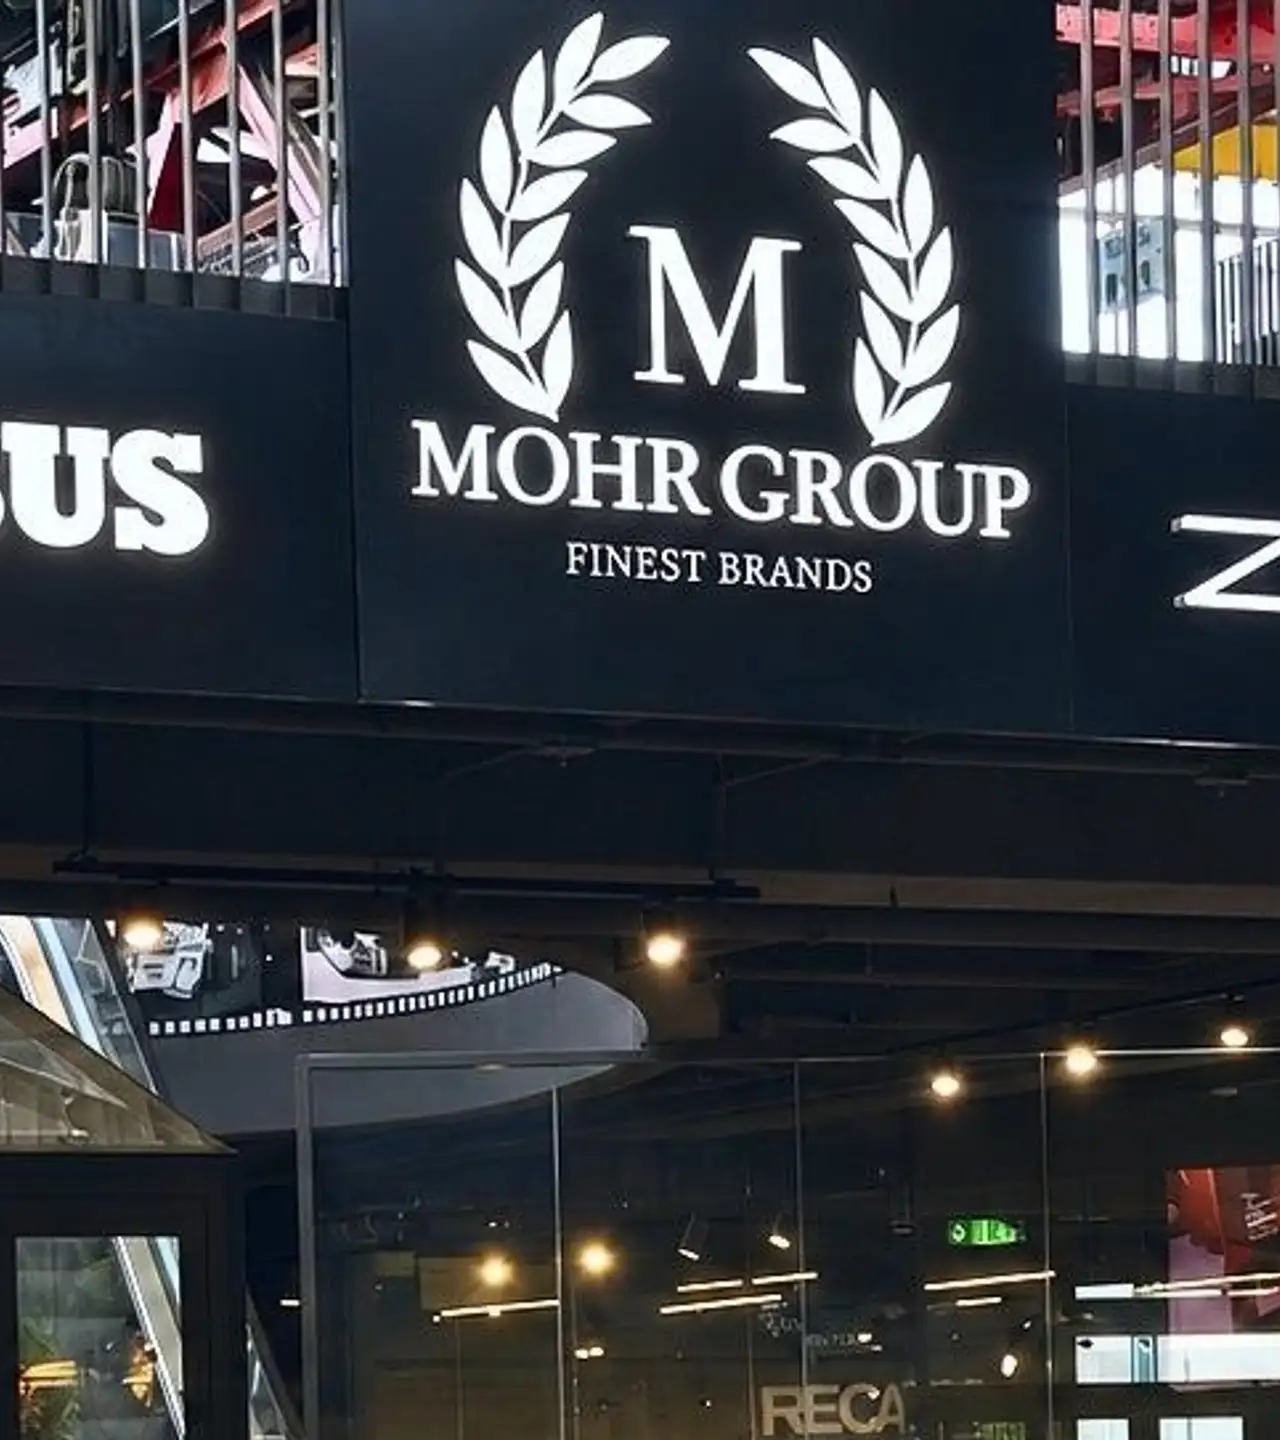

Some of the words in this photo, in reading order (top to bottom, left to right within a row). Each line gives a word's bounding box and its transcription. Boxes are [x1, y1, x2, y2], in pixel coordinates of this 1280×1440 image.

[629, 226, 806, 394] M
[412, 419, 712, 516] MOHR
[720, 443, 1031, 540] GROUP
[566, 542, 707, 584] FINEST
[718, 551, 873, 593] BRANDS
